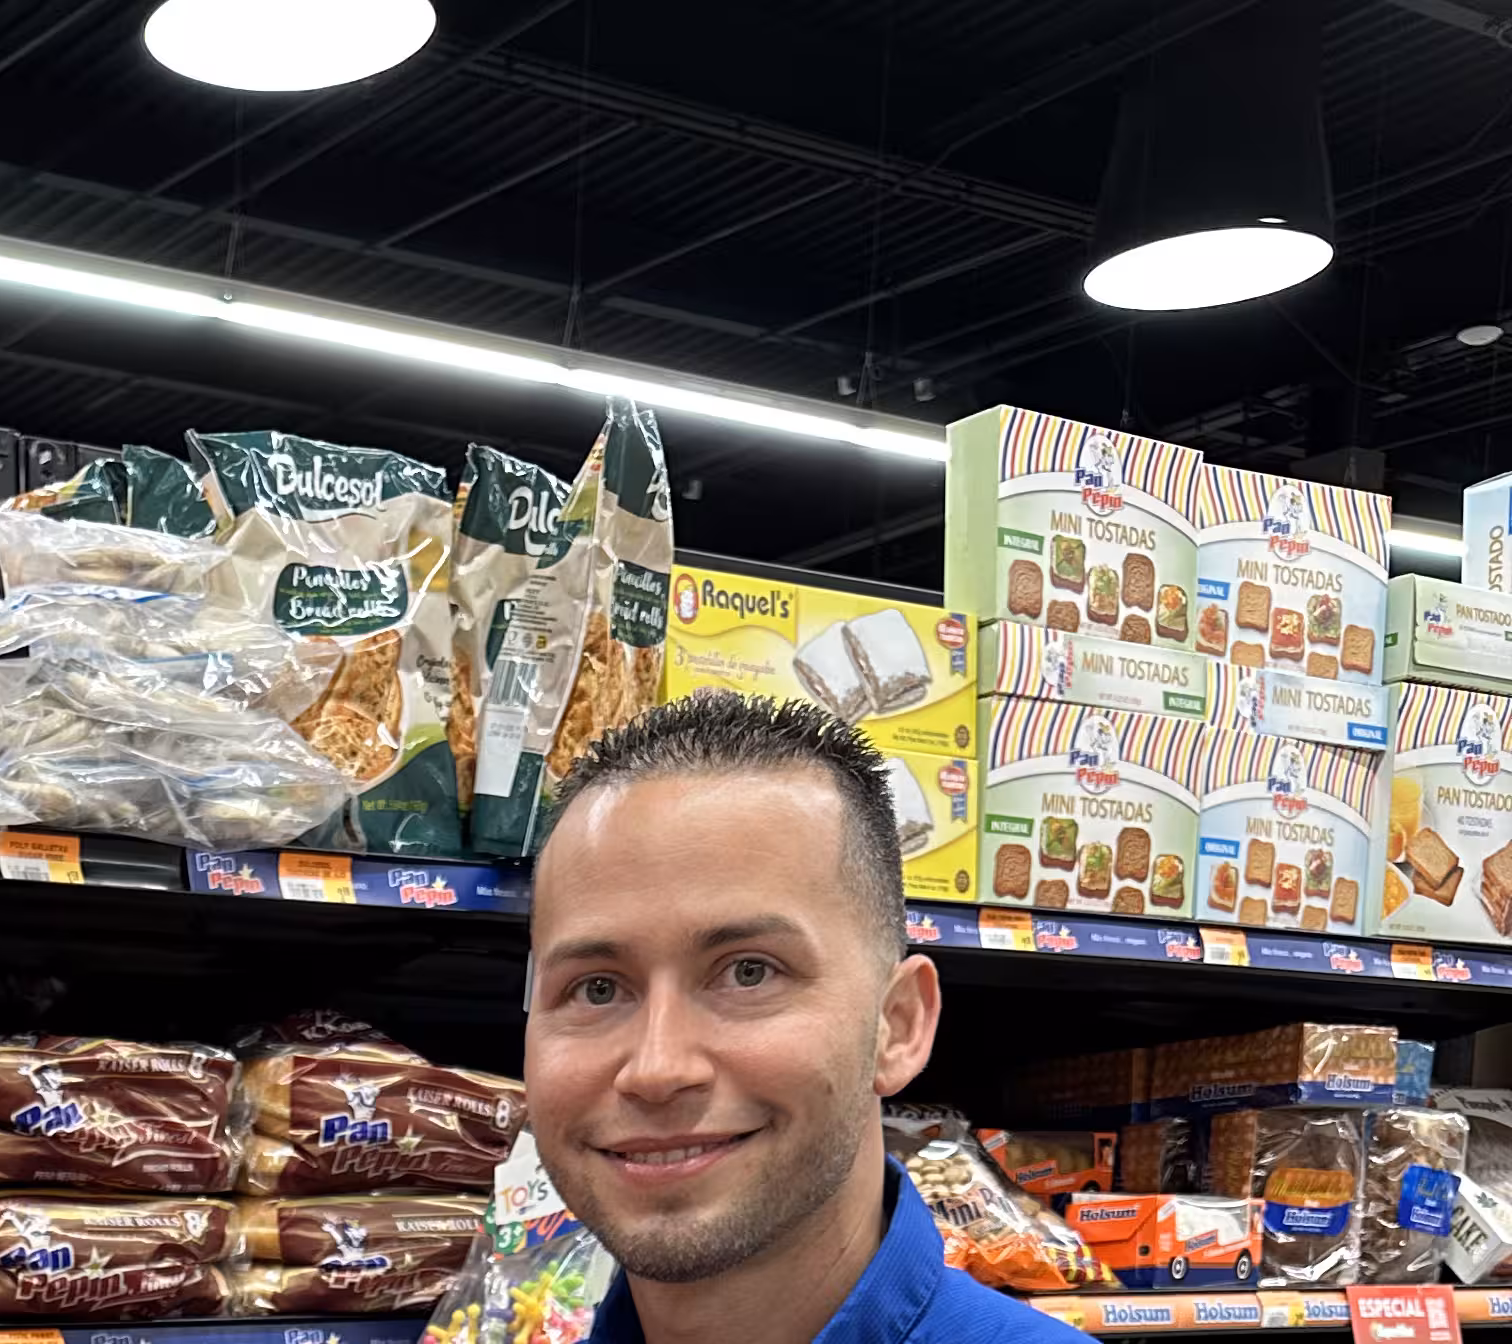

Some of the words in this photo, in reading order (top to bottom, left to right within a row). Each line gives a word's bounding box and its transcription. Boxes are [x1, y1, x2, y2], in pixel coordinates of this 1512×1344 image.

[271, 454, 387, 510] Dulcesol
[1074, 469, 1103, 487] Pan
[1050, 510, 1082, 534] MINI
[1087, 517, 1156, 551] TOSTADAS
[1263, 516, 1290, 535] Pan
[1237, 558, 1267, 581] MINI
[1273, 563, 1343, 594] TOSTADAS
[701, 578, 790, 620] Raquel's
[1456, 603, 1472, 619] PAN
[1081, 651, 1113, 674] MINI
[1119, 657, 1189, 687] TOSTADAS
[1272, 686, 1301, 707] MINI
[1306, 690, 1372, 718] TOSTADAS
[1070, 750, 1099, 768] Pan
[1457, 739, 1483, 756] Pan
[1268, 777, 1293, 793] Pan
[1437, 785, 1461, 807] PAN
[1042, 793, 1076, 815] MINI
[1080, 797, 1153, 824] TOSTADAS
[1246, 816, 1272, 836] MINI
[1276, 820, 1336, 847] TOSTADAS
[1325, 1074, 1372, 1092] Holsum
[318, 1113, 392, 1147] Pan
[1078, 1203, 1139, 1222] Holsum
[1451, 1203, 1488, 1255] CAKE
[1101, 1301, 1174, 1327] Holsum
[1194, 1301, 1261, 1324] Holsum
[1357, 1297, 1426, 1319] ESPECIAL
